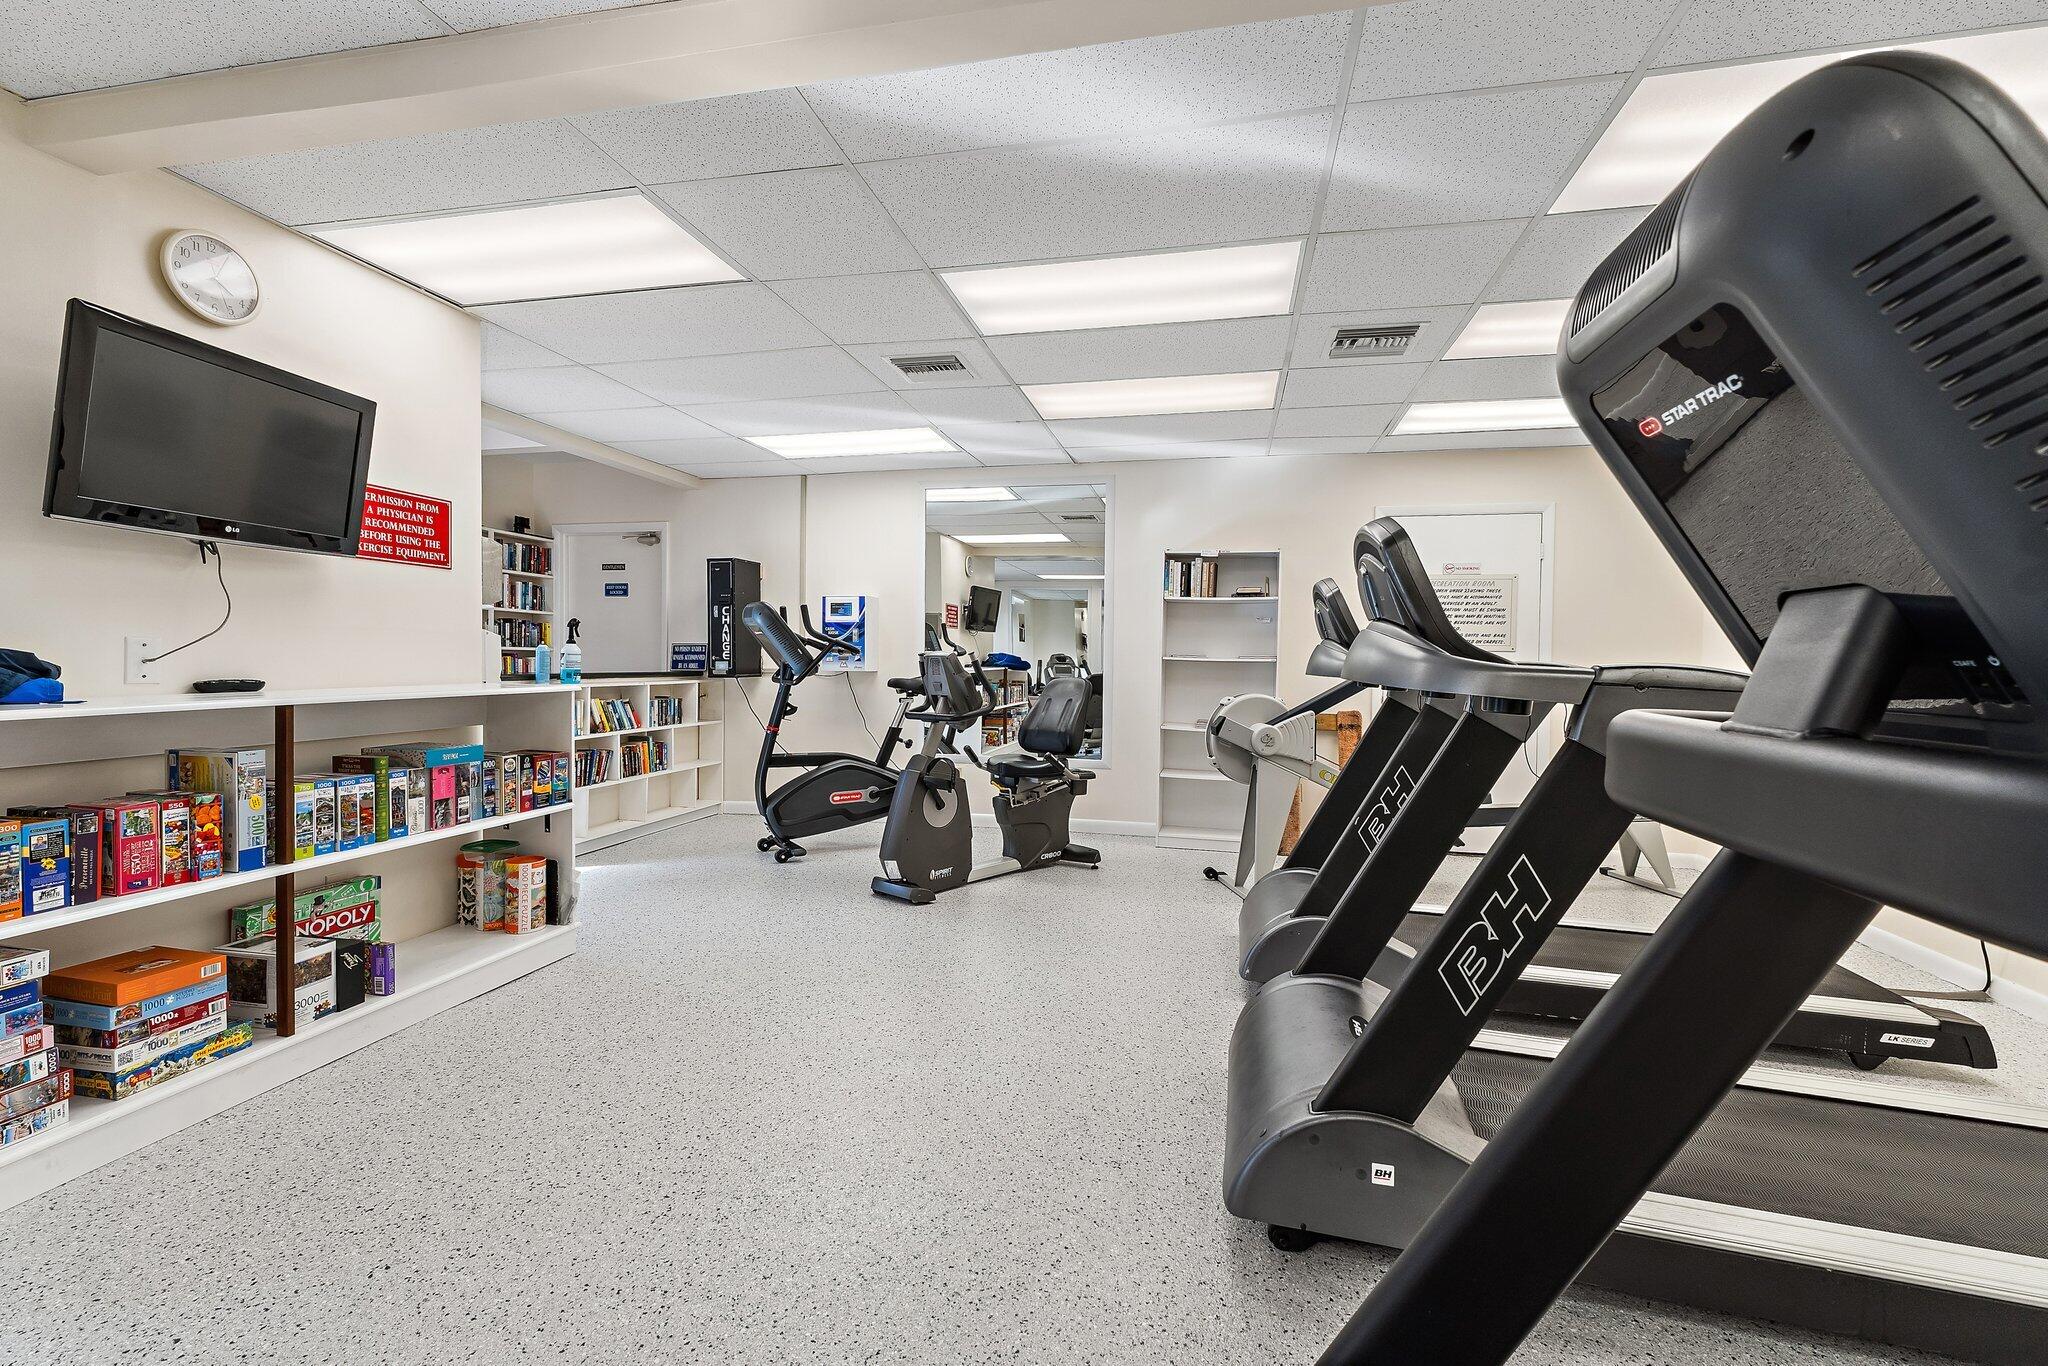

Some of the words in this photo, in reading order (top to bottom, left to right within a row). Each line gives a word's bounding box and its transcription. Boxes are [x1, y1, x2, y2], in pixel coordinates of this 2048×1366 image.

[180, 247, 191, 258] 10
[193, 241, 200, 252] 11
[206, 242, 216, 253] 12
[1661, 397, 1700, 426] STAR
[1695, 374, 1742, 406] TRAC
[364, 491, 413, 508] ERMISSION
[415, 501, 439, 514] FROM
[366, 505, 374, 514] A
[376, 506, 423, 522] PHYSICIAN
[425, 515, 433, 524] IS
[364, 517, 435, 536] RECOMMENDED
[358, 542, 393, 555] XERCISE
[396, 547, 447, 561] EQUIPMENT.
[395, 535, 421, 547] USING
[424, 539, 441, 549] THE
[722, 606, 730, 660] CHANGE
[1358, 764, 1416, 854] BH
[251, 815, 265, 836] 500
[131, 853, 142, 875] 550
[296, 904, 372, 937] NOPOLY
[1437, 854, 1552, 1016] BH
[144, 998, 165, 1012] 1000
[295, 993, 320, 1010] 3000
[150, 1012, 174, 1026] 1000
[25, 1032, 41, 1043] 1000
[147, 1037, 169, 1051] 1000
[195, 1049, 207, 1058] THE
[207, 1044, 223, 1054] HAPPY
[225, 1036, 241, 1047] ISLES
[1900, 1036, 1929, 1046] SERIES
[48, 1051, 57, 1073] 2000
[1374, 1167, 1392, 1180] BH
